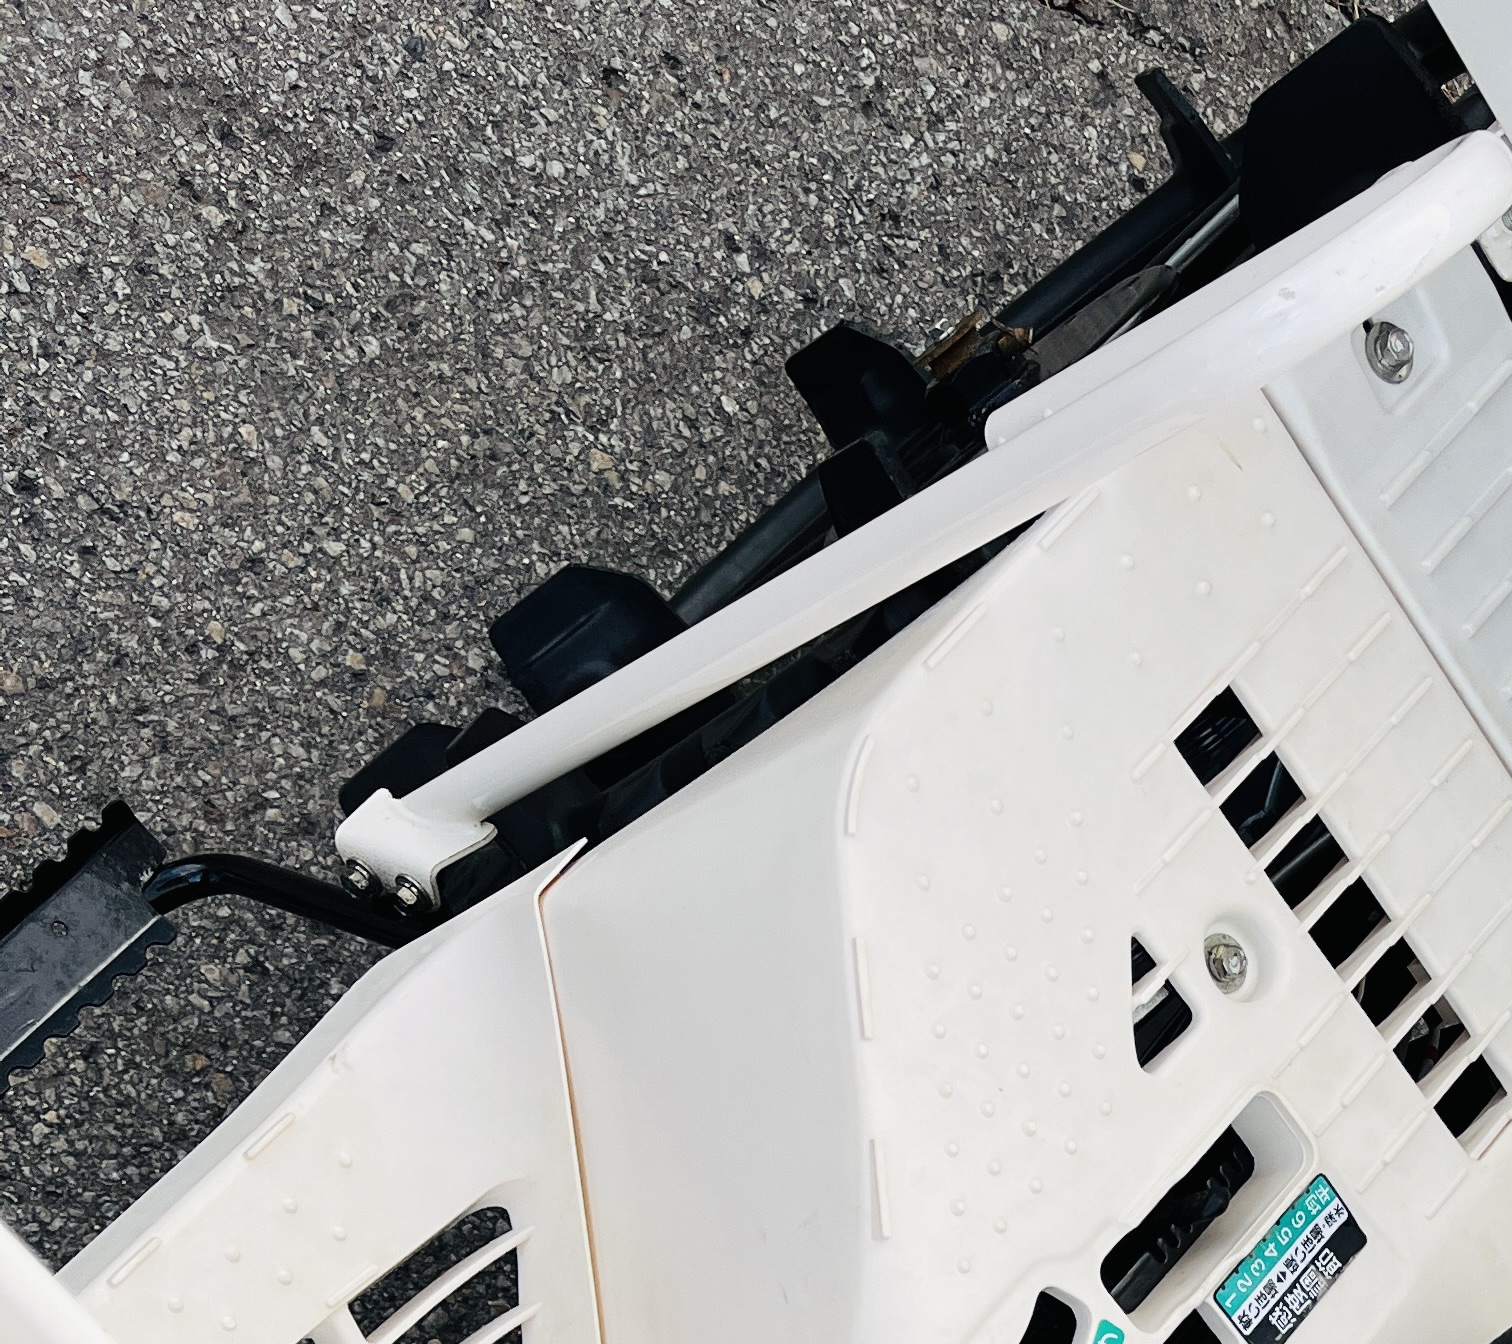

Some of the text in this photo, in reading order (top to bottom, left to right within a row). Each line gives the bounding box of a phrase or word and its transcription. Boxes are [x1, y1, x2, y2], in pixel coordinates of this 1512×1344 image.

[1225, 1291, 1239, 1309] 1
[1238, 1272, 1254, 1292] 2
[1251, 1258, 1267, 1277] 3
[1264, 1242, 1281, 1258] 4
[1278, 1226, 1294, 1245] 5
[1291, 1210, 1306, 1229] 6
[1268, 1246, 1343, 1335] 感度調節
